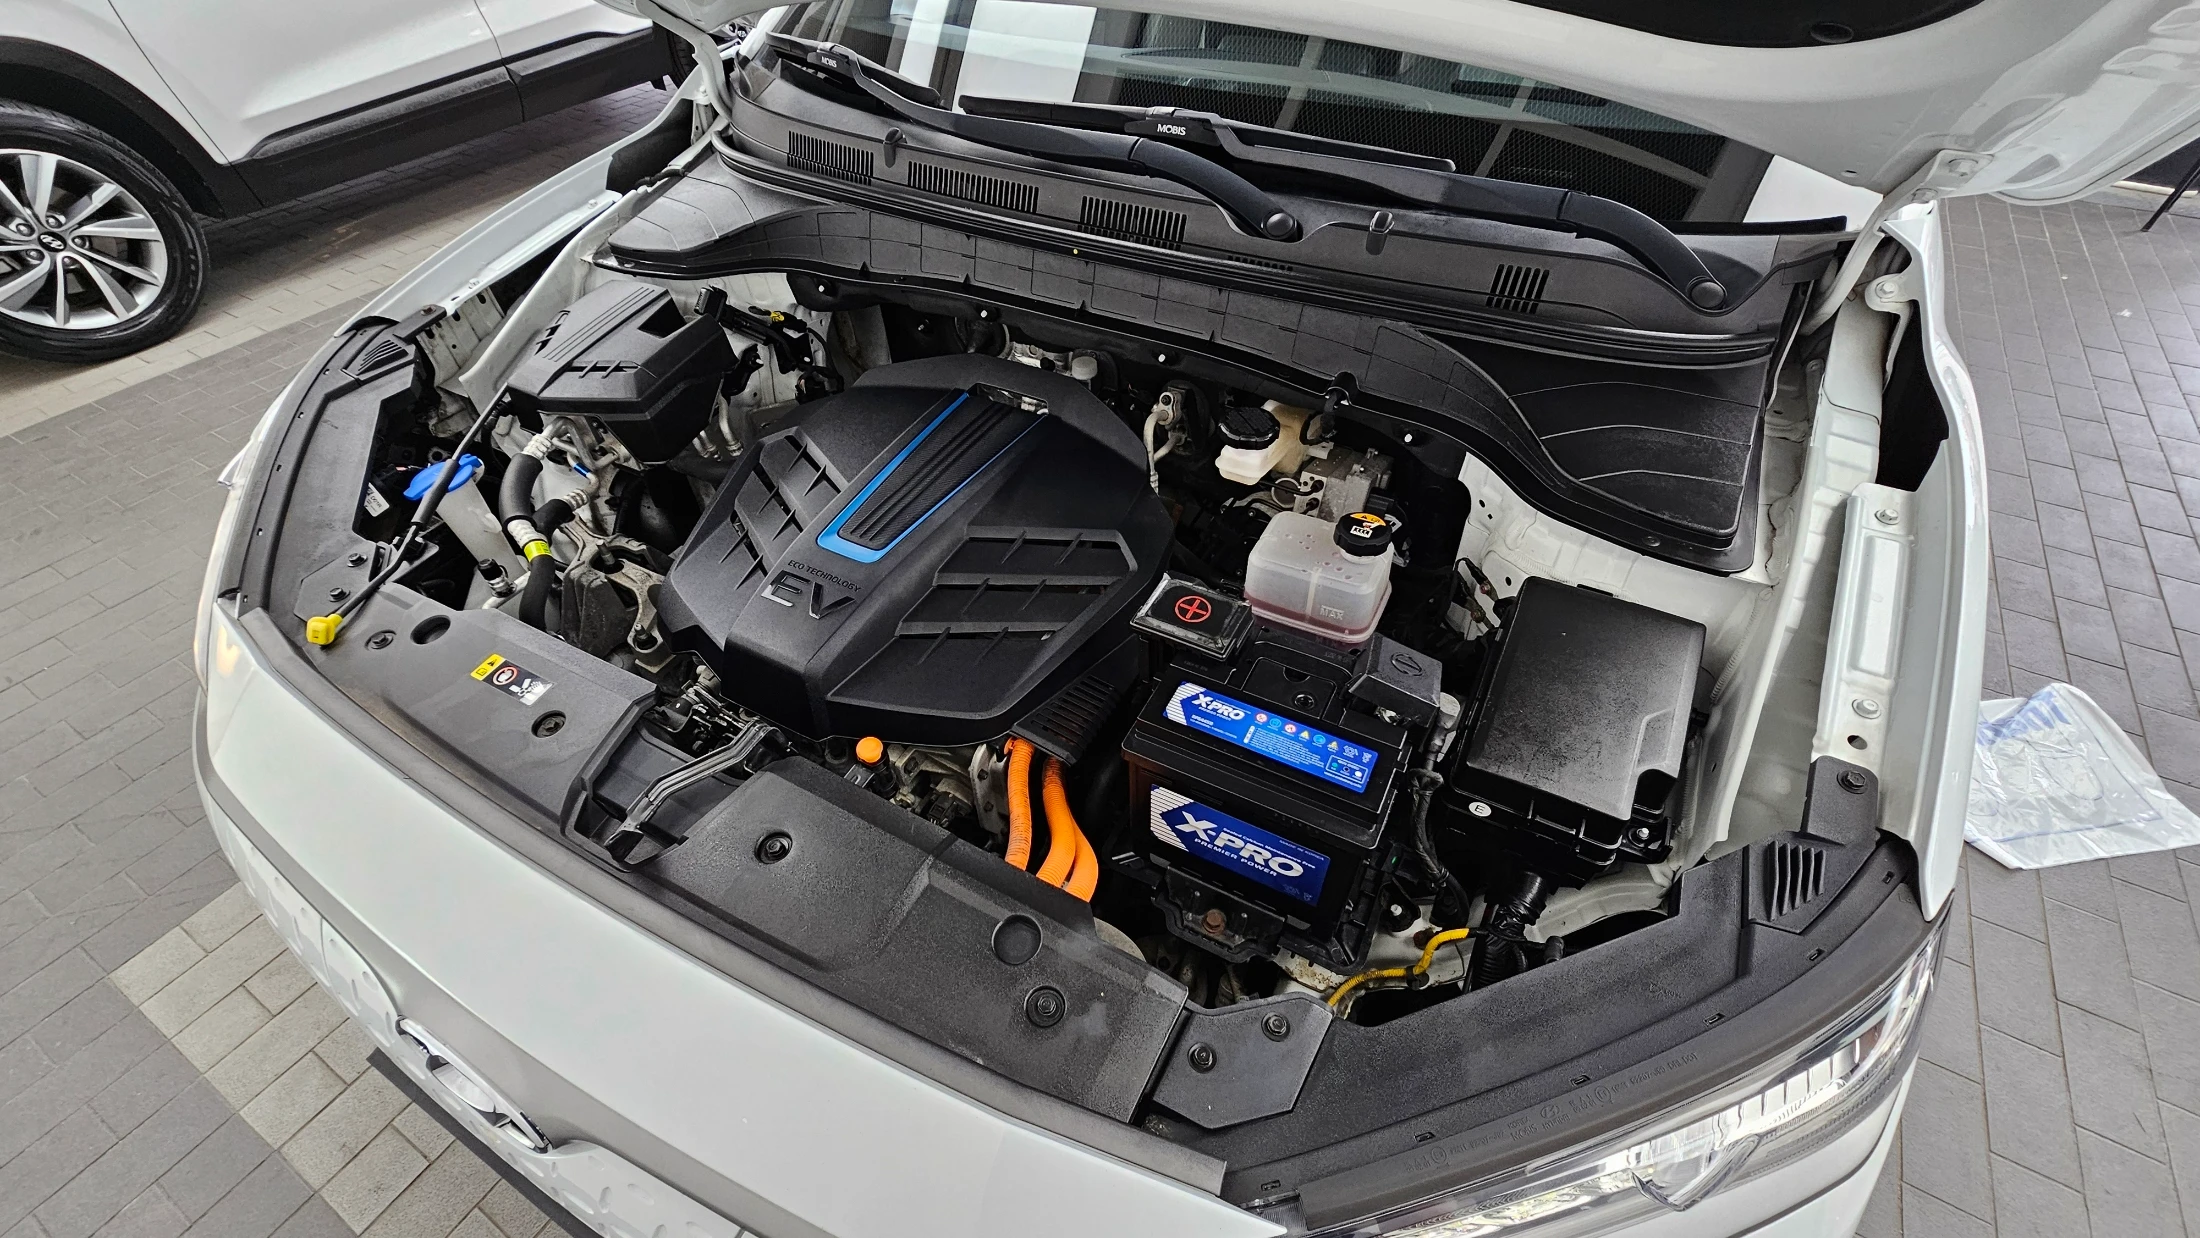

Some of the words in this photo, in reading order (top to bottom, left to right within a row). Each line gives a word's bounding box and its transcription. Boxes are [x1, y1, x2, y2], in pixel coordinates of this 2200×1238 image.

[1157, 123, 1186, 136] MOBIS
[788, 560, 805, 571] ECO
[806, 565, 861, 592] TECHNOLOGY
[761, 570, 856, 619] EV
[1320, 608, 1344, 620] MAX
[1191, 693, 1245, 720] X-PRO
[1475, 804, 1485, 814] E
[1175, 810, 1303, 877] X-PRO
[1194, 838, 1238, 860] PREMIER
[1240, 858, 1277, 877] POWER
[1302, 861, 1316, 869] Free
